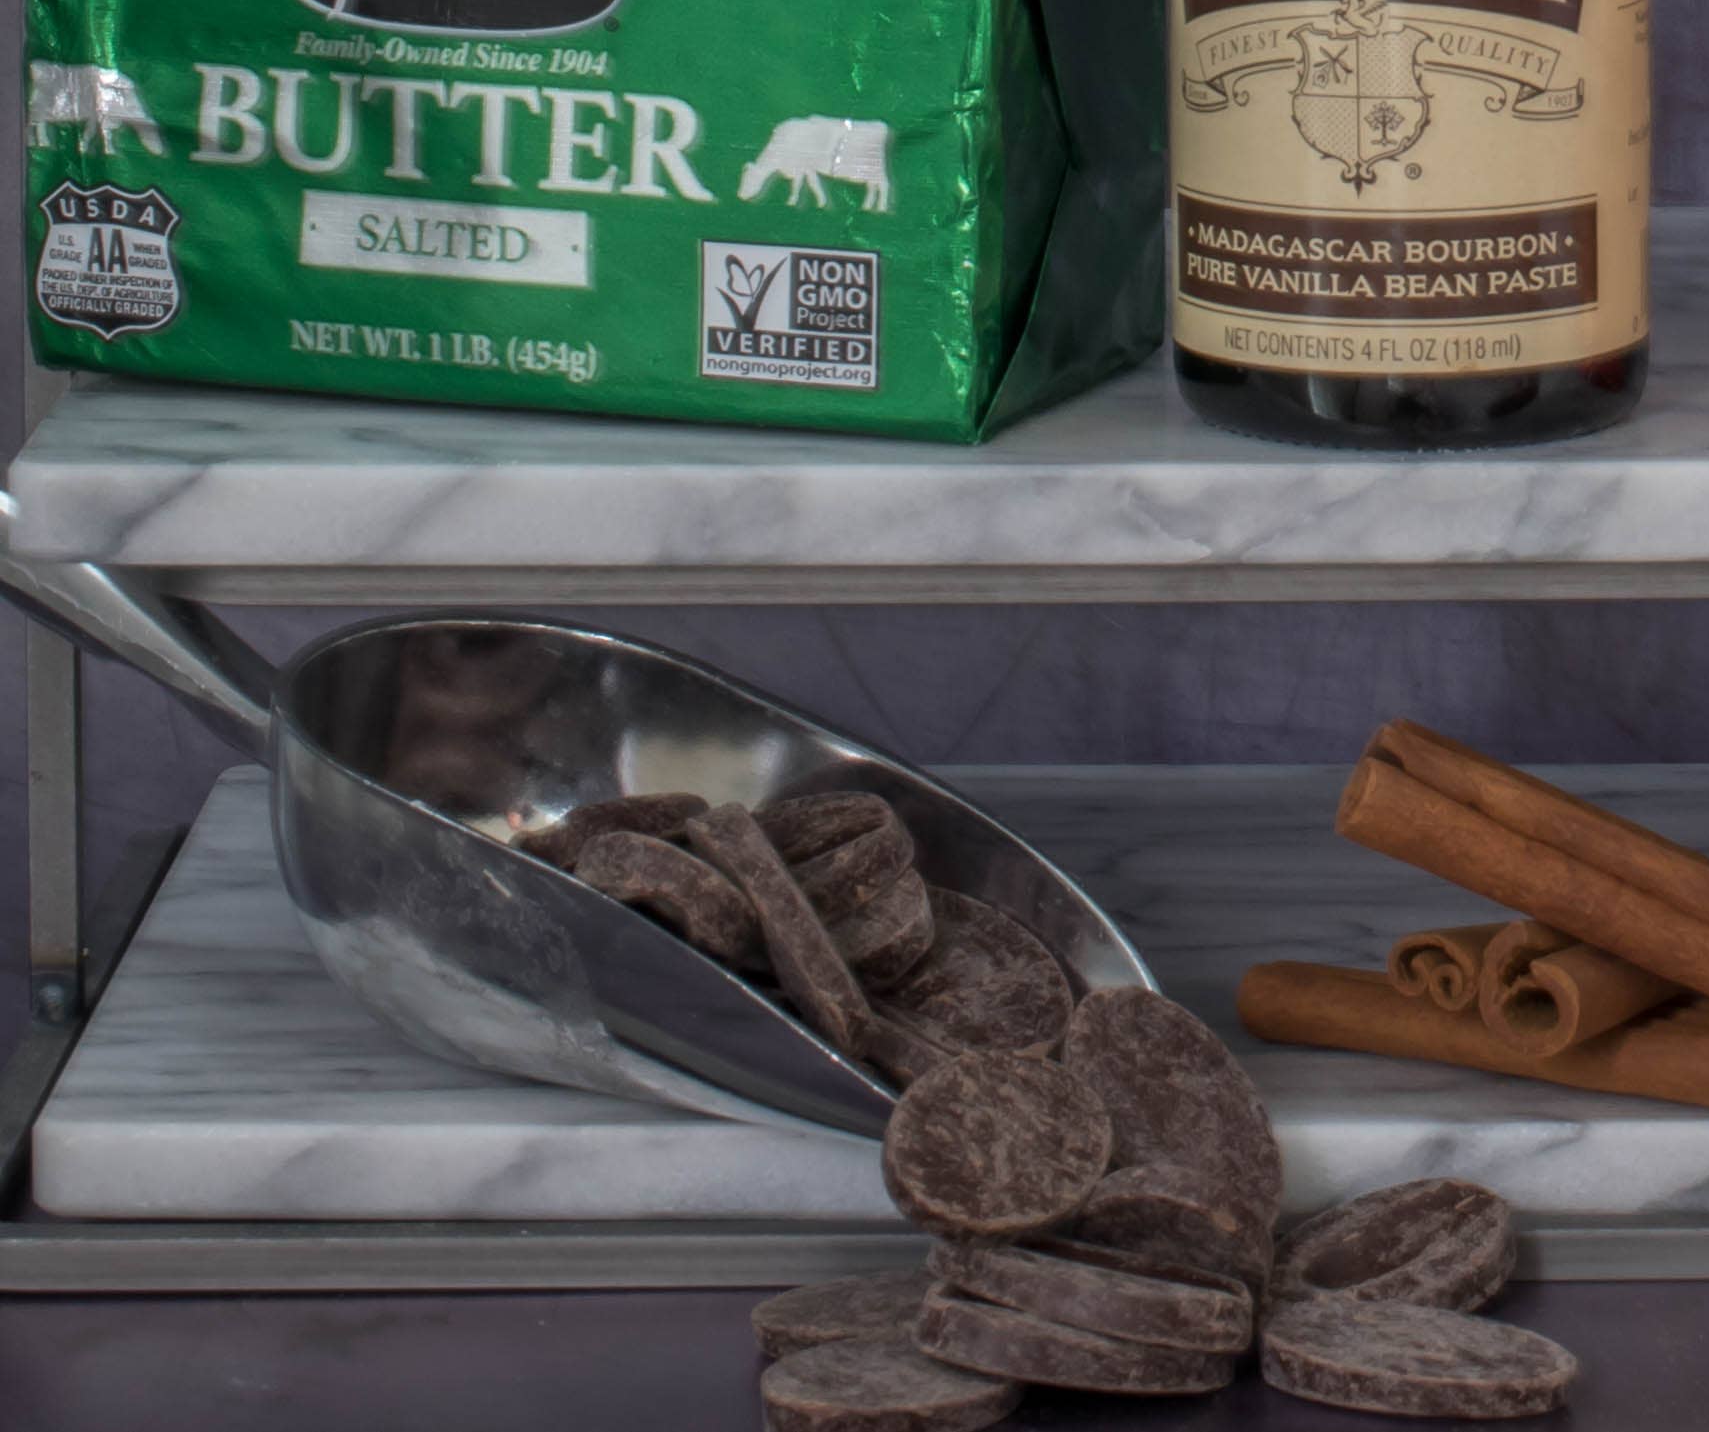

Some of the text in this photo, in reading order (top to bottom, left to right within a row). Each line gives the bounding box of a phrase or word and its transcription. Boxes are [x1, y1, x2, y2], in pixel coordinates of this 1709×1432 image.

[474, 43, 542, 71] Since
[1437, 31, 1552, 75] QUALITY
[190, 62, 717, 202] BUTTER
[60, 198, 155, 225] USDA
[87, 227, 129, 274] AA
[356, 214, 529, 263] SALTED
[1198, 222, 1558, 264] MADAGASCAR BOURBON
[800, 259, 865, 284] NON
[1187, 252, 1578, 299] PURE VANILLA BEAN PASTE
[797, 284, 867, 310] GMO
[797, 307, 864, 330] Project
[290, 319, 598, 385] NET (454g)
[716, 331, 866, 361] VERIFIED
[1224, 326, 1354, 362] NET CONTENTS
[706, 358, 872, 385] nongmoproject.org
